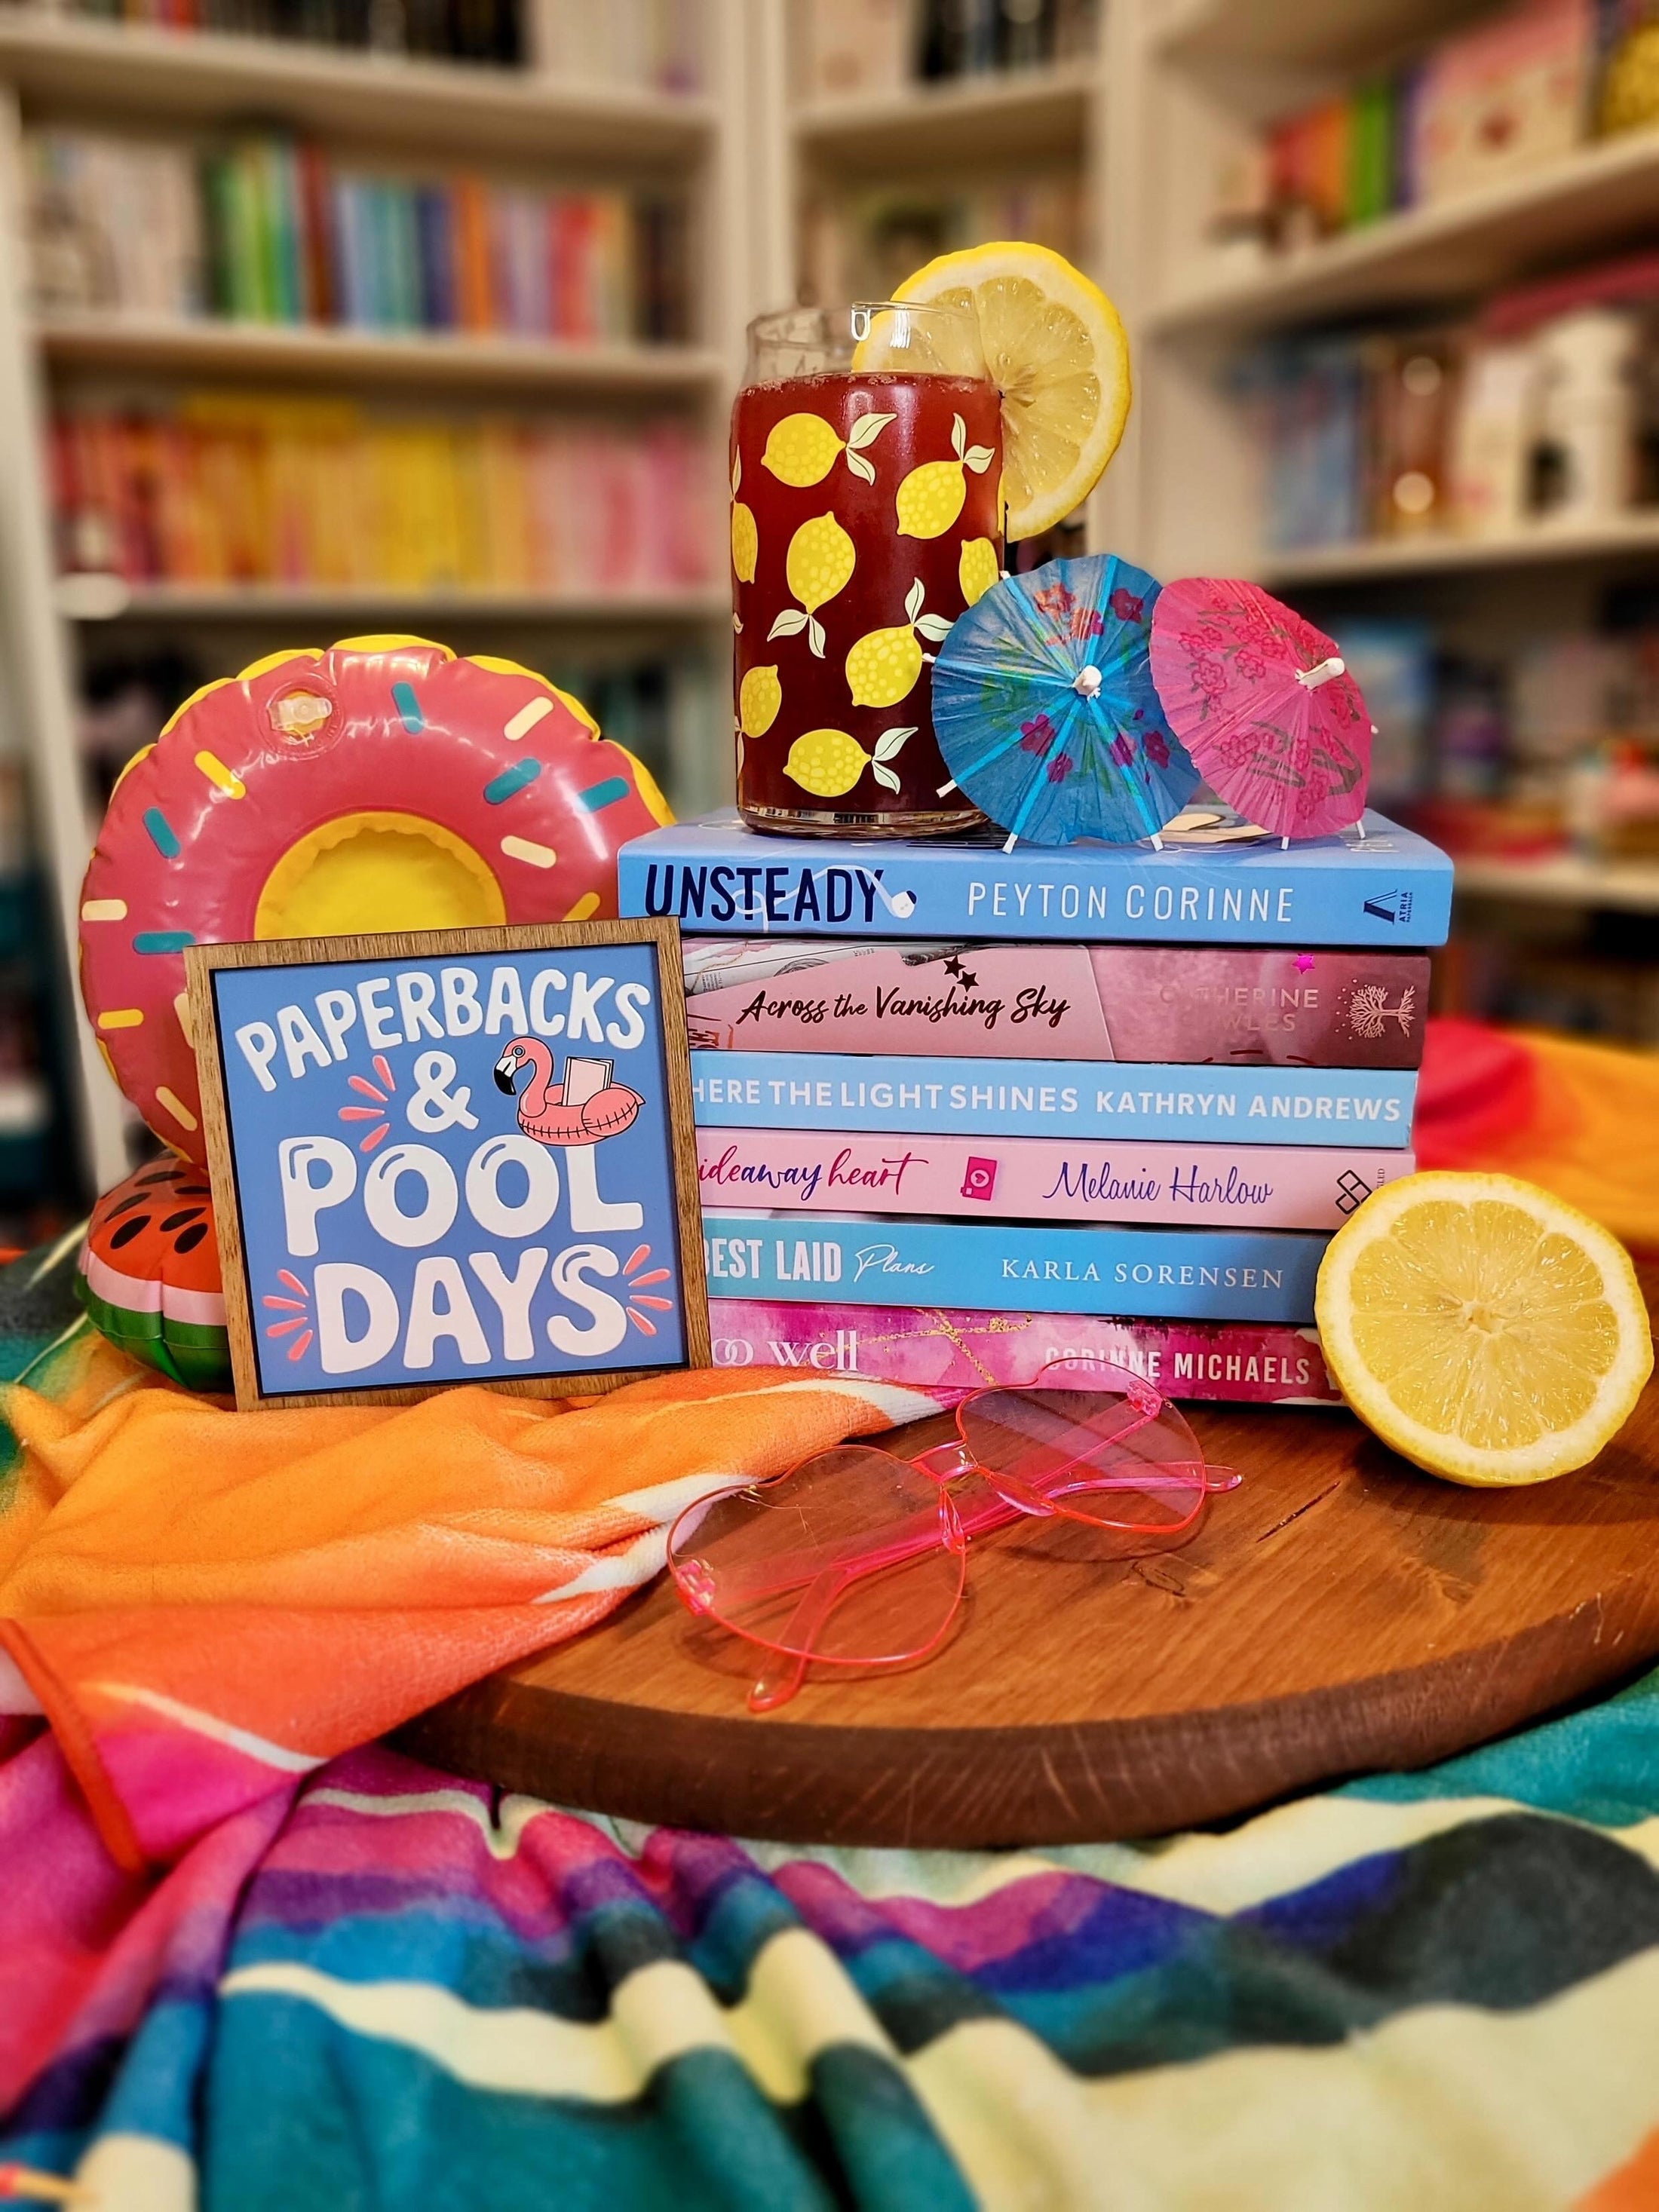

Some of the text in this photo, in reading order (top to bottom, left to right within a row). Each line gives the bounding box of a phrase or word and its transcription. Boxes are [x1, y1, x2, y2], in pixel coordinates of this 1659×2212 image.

[644, 864, 1294, 923] UNSTEADY PEYTON CORINNE
[1399, 892, 1409, 923] ATRIA
[235, 967, 651, 1092] PAPERBACKS
[735, 985, 1071, 1028] Across the Vanishing Sky
[406, 1050, 480, 1133] &
[694, 1078, 1401, 1121] HERE THE LIGHT SHINES KATHRYN ANDREWS
[278, 1135, 644, 1258] POOL
[698, 1145, 1273, 1204] ideaway heart Melanie Harlow
[776, 1240, 842, 1282] LAID
[853, 1244, 934, 1282] Plans
[1001, 1259, 1101, 1281] KARLA
[1114, 1264, 1283, 1288] SORENSEN
[314, 1244, 628, 1374] DAYS
[712, 1329, 1311, 1385] oo well CORINNE MICHAELS
